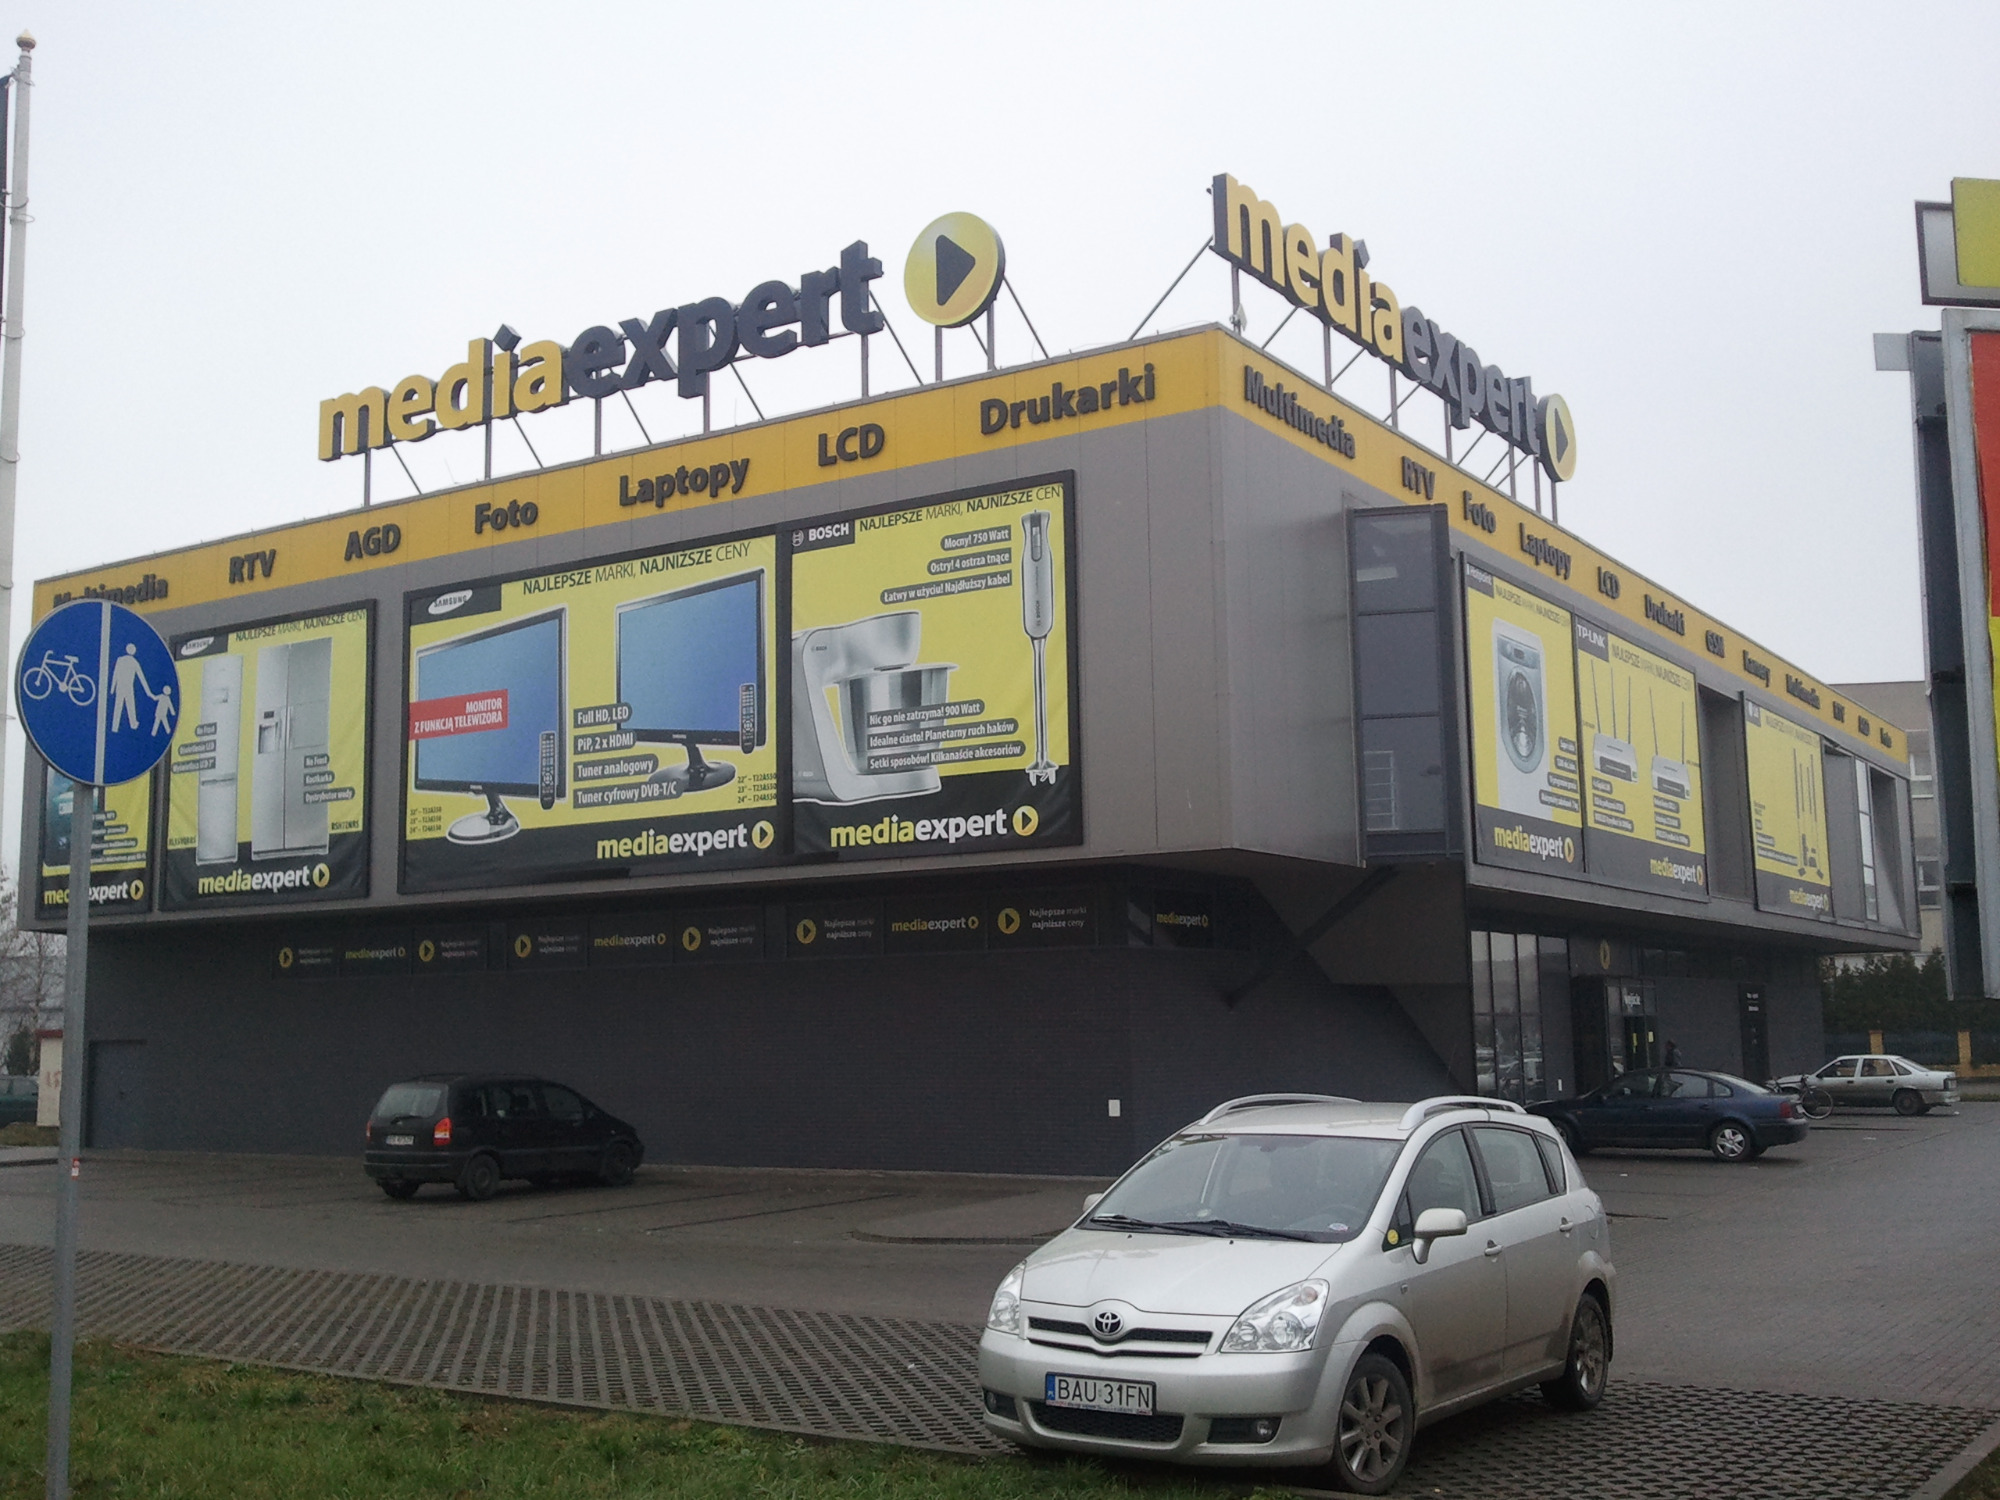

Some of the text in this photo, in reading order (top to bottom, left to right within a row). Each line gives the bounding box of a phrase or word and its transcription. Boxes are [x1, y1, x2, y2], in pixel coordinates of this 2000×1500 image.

[1213, 172, 1541, 456] mediaexpert
[318, 240, 884, 462] mediaexpert
[981, 363, 1156, 434] Drukarki
[1244, 365, 1355, 459] Multimedia
[818, 423, 885, 467] LCD
[619, 458, 750, 508] Laptopy
[1402, 456, 1435, 500] RTV
[474, 499, 538, 534] Foto
[859, 510, 923, 532] NAJLEPSZE
[925, 503, 963, 520] MARKI,
[966, 490, 1033, 512] NAJNIŻSZE
[1463, 490, 1496, 533] Foto
[344, 523, 401, 560] AGD
[808, 522, 849, 542] BOSCH
[944, 529, 1009, 550] Mocny! 750 Watt
[930, 552, 1009, 574] Ostry! 4 ostrza tnące
[1519, 523, 1571, 580] Laptopy
[228, 549, 276, 584] RTV
[523, 542, 750, 595] NAJLEPSZE MARKI, NAJNIŻSZE CENY
[987, 573, 1010, 585] kabel
[1598, 565, 1620, 600] LCD
[433, 594, 467, 608] SAMSUNG
[236, 628, 276, 641] NAJLEPSZE
[1577, 624, 1606, 648] TP-LINK
[466, 698, 502, 714] MONITOR
[577, 706, 629, 724] Full HD, LED
[906, 708, 944, 723] zatrzyma!
[945, 706, 960, 716] 900
[961, 702, 980, 714] Watt
[414, 711, 502, 734] Z FUNKCJĄ TELEWIZORA
[870, 721, 1014, 747] Idealne ciasto! Planetarny ruch haków
[577, 732, 633, 751] PiP, 2 x HDMI
[577, 759, 653, 777] Tuner analogowy
[870, 743, 1020, 769] Setki sposobów! Kilkanaście akcesoriów
[577, 782, 677, 804] Tuner cyfrowy DVB-T/C
[597, 823, 748, 859] mediaexpert
[830, 808, 1007, 847] mediaexpert
[1494, 825, 1563, 860] mediaexpert
[198, 862, 310, 898] mediaexpert
[1650, 857, 1696, 885] mediaexpert
[892, 916, 966, 932] mediaexpert
[1157, 911, 1201, 927] mediaexpert
[345, 947, 396, 960] mediaexpert
[594, 934, 656, 948] mediaexpert
[1058, 1378, 1096, 1402] BAU
[1104, 1383, 1149, 1408] 31FN
